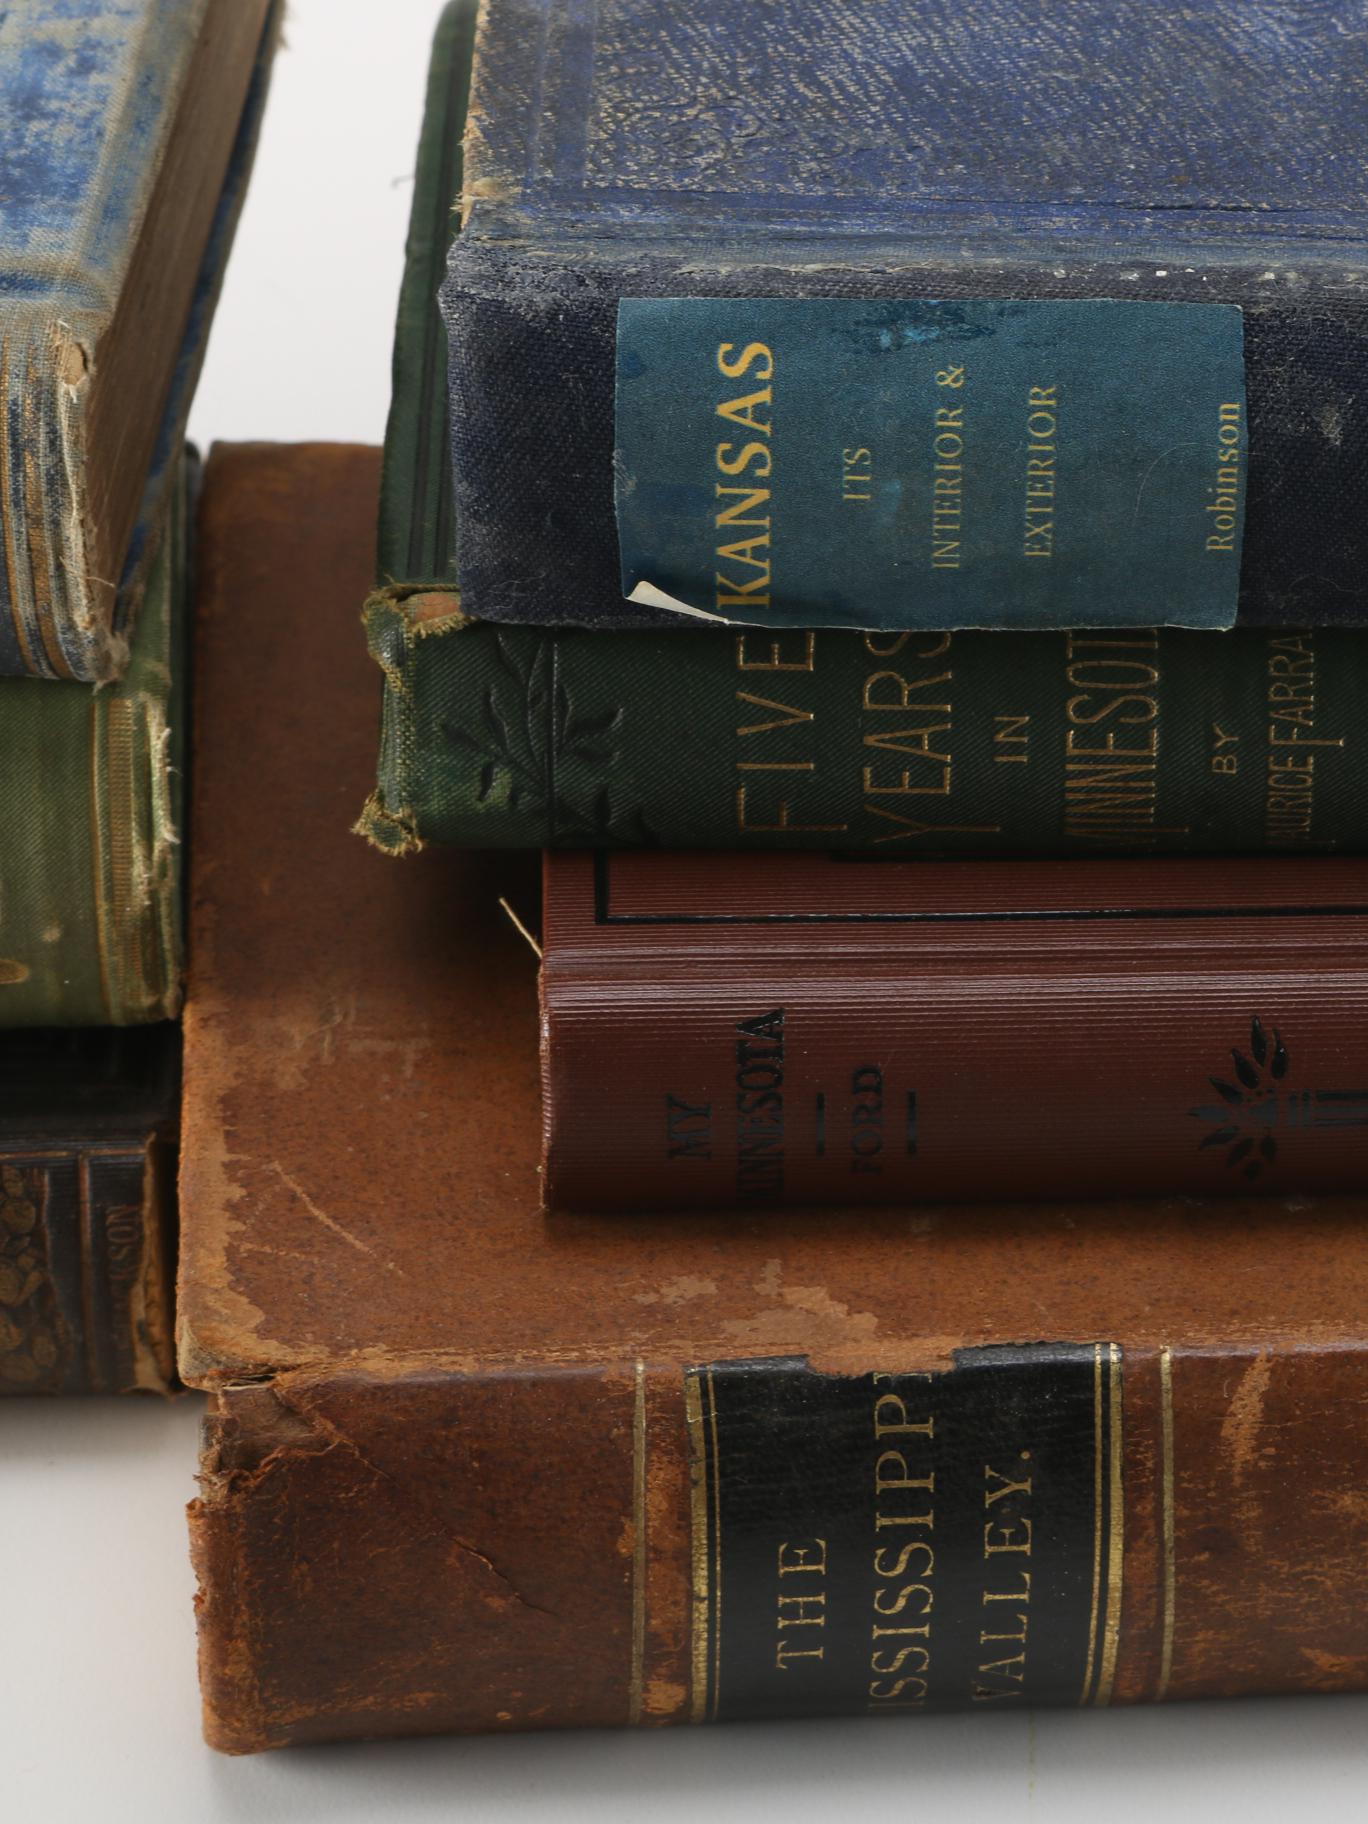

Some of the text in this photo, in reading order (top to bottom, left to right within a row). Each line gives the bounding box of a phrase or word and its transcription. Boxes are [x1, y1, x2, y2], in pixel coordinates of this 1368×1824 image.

[714, 340, 775, 609] KANSAS
[841, 447, 873, 502] ITS
[930, 363, 966, 570] INTERIOR &
[1023, 385, 1059, 558] EXTERIOR
[1206, 401, 1242, 552] Robinson
[736, 633, 848, 832] FIVE
[861, 631, 1003, 843] YEARS
[993, 714, 1030, 764] IN
[1063, 628, 1190, 852] MINNESOT
[1210, 723, 1240, 775] BY
[1266, 626, 1345, 747] FARRA
[665, 1093, 713, 1161] MY
[850, 1064, 883, 1176] FORD
[775, 1538, 827, 1669] THE
